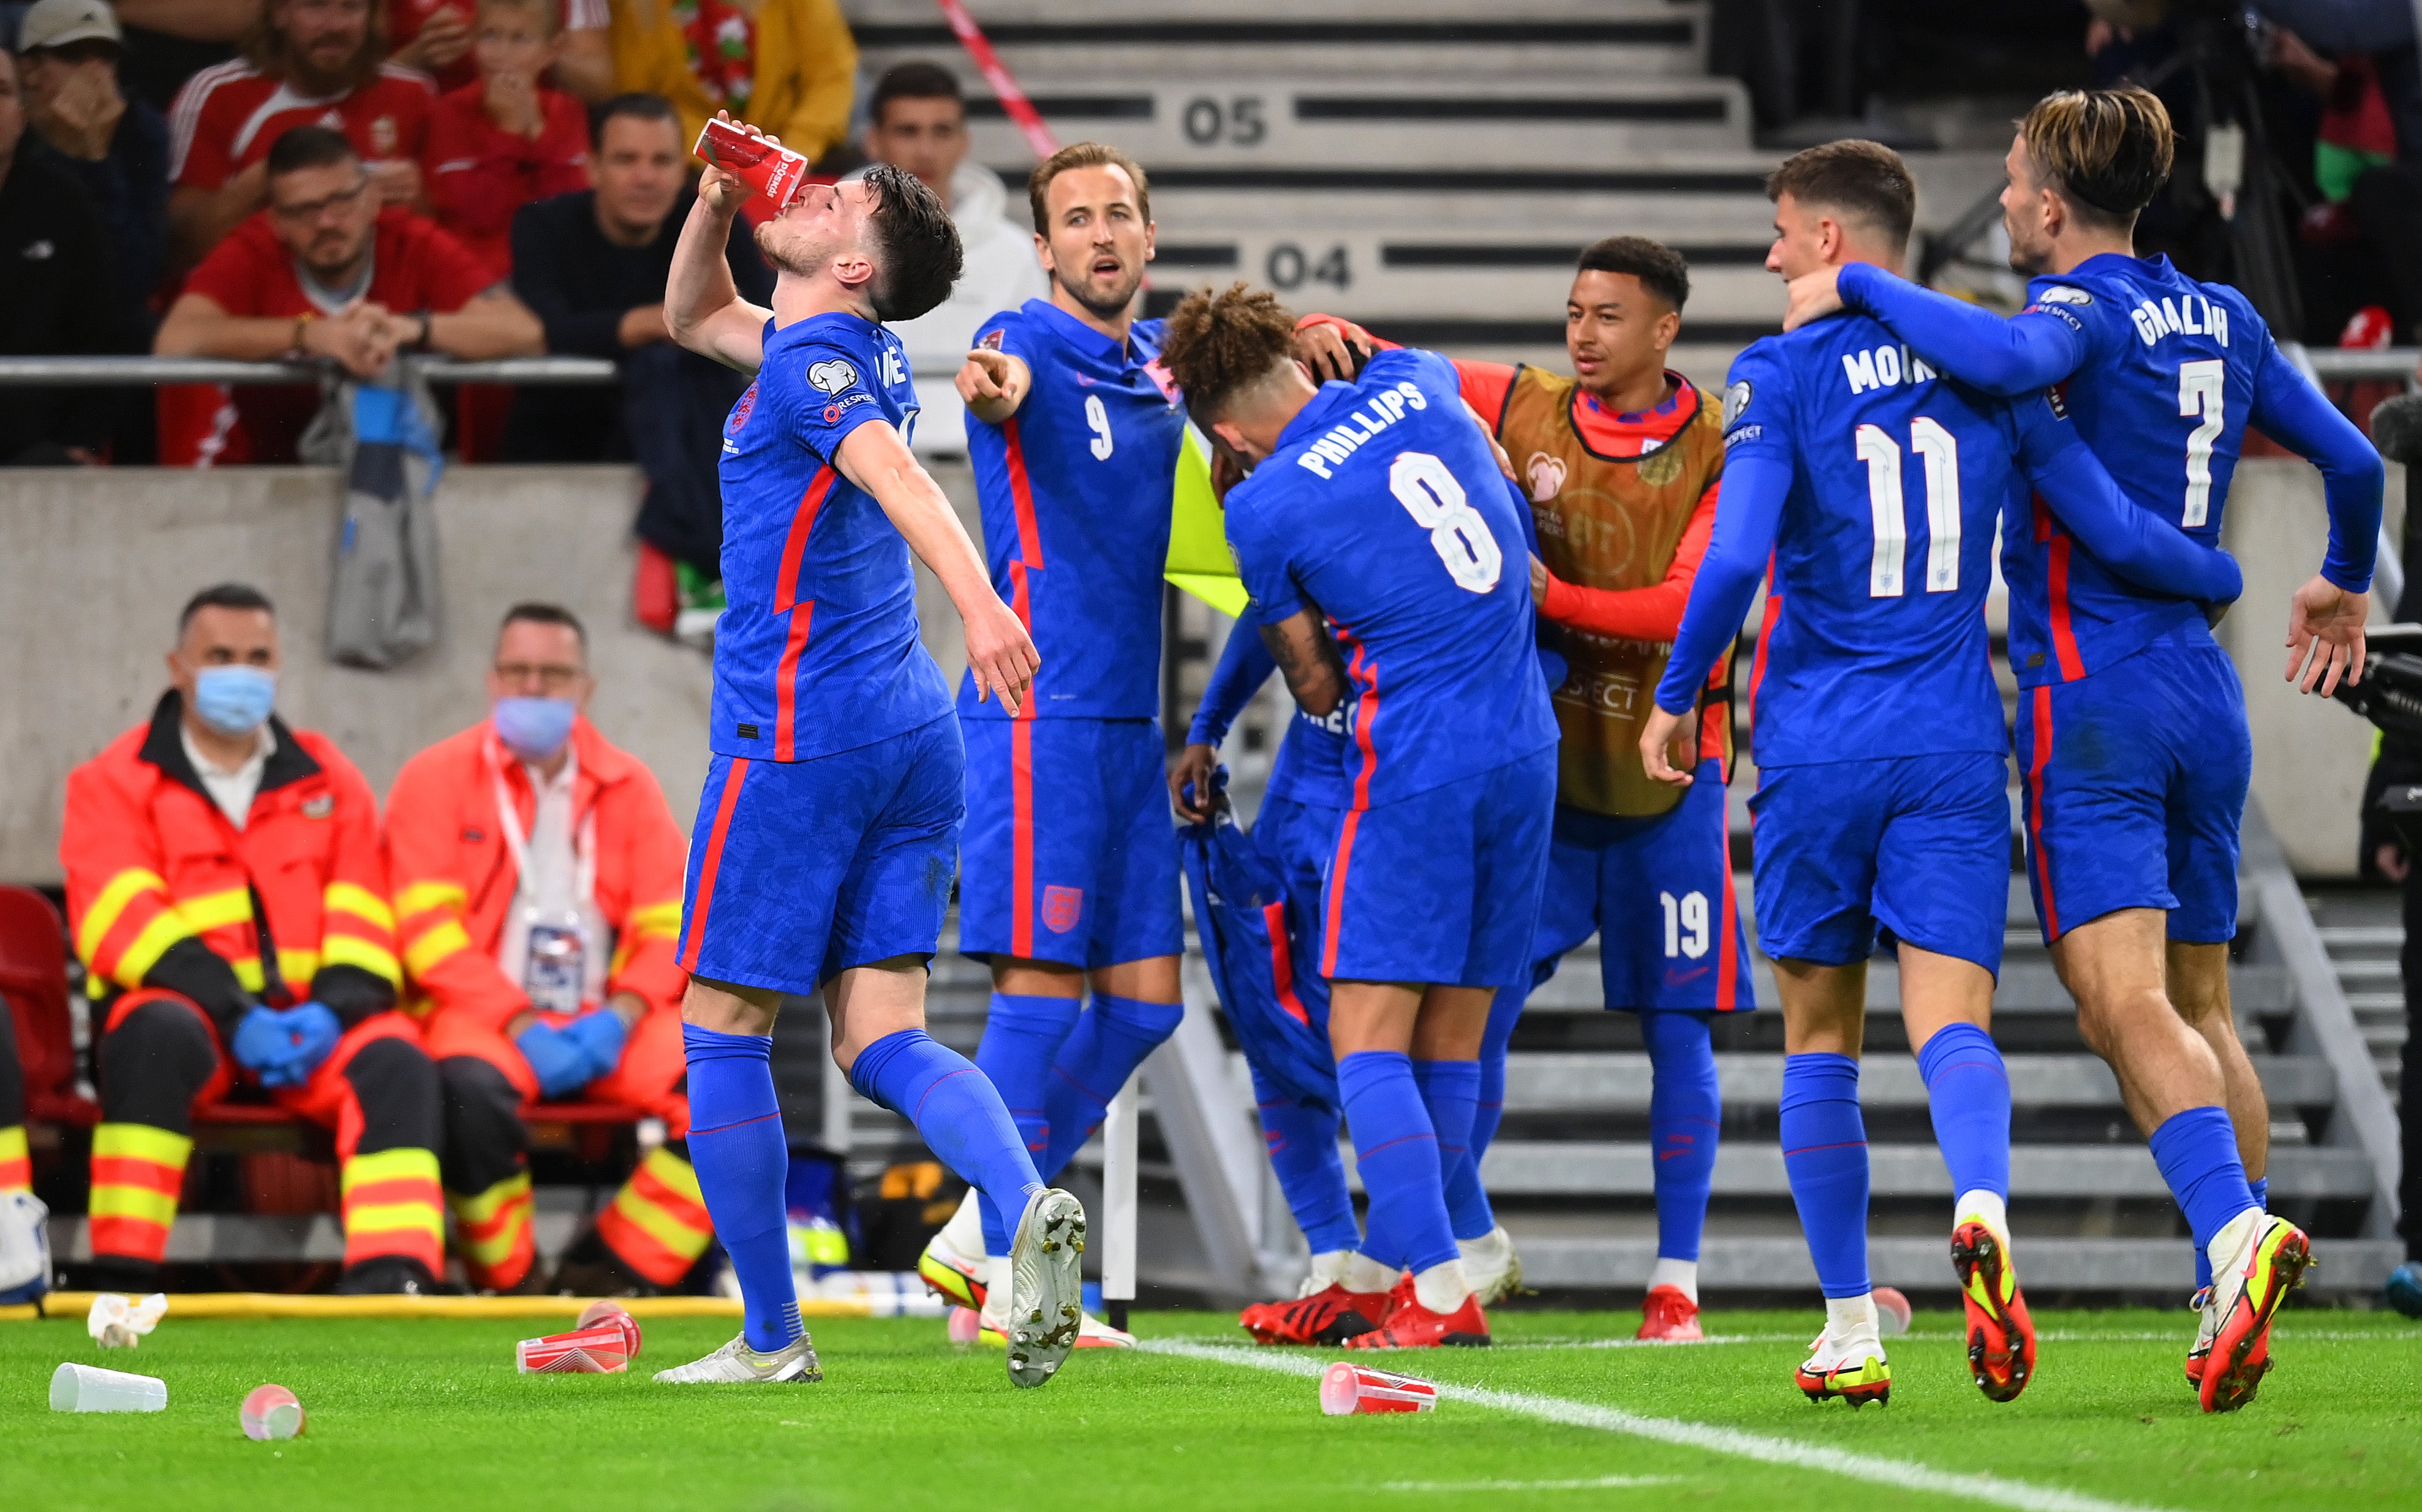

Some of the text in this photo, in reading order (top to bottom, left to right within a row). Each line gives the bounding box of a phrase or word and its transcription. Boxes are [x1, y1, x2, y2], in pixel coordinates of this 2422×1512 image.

[1183, 97, 1267, 147] 05
[1266, 244, 1351, 292] 04
[1085, 394, 1113, 461] 9
[1297, 382, 1427, 480] PHILLIPS
[2178, 358, 2224, 528] 7
[1389, 451, 1503, 594] 8
[1855, 416, 1962, 598] 11
[1660, 890, 1710, 961] 19
